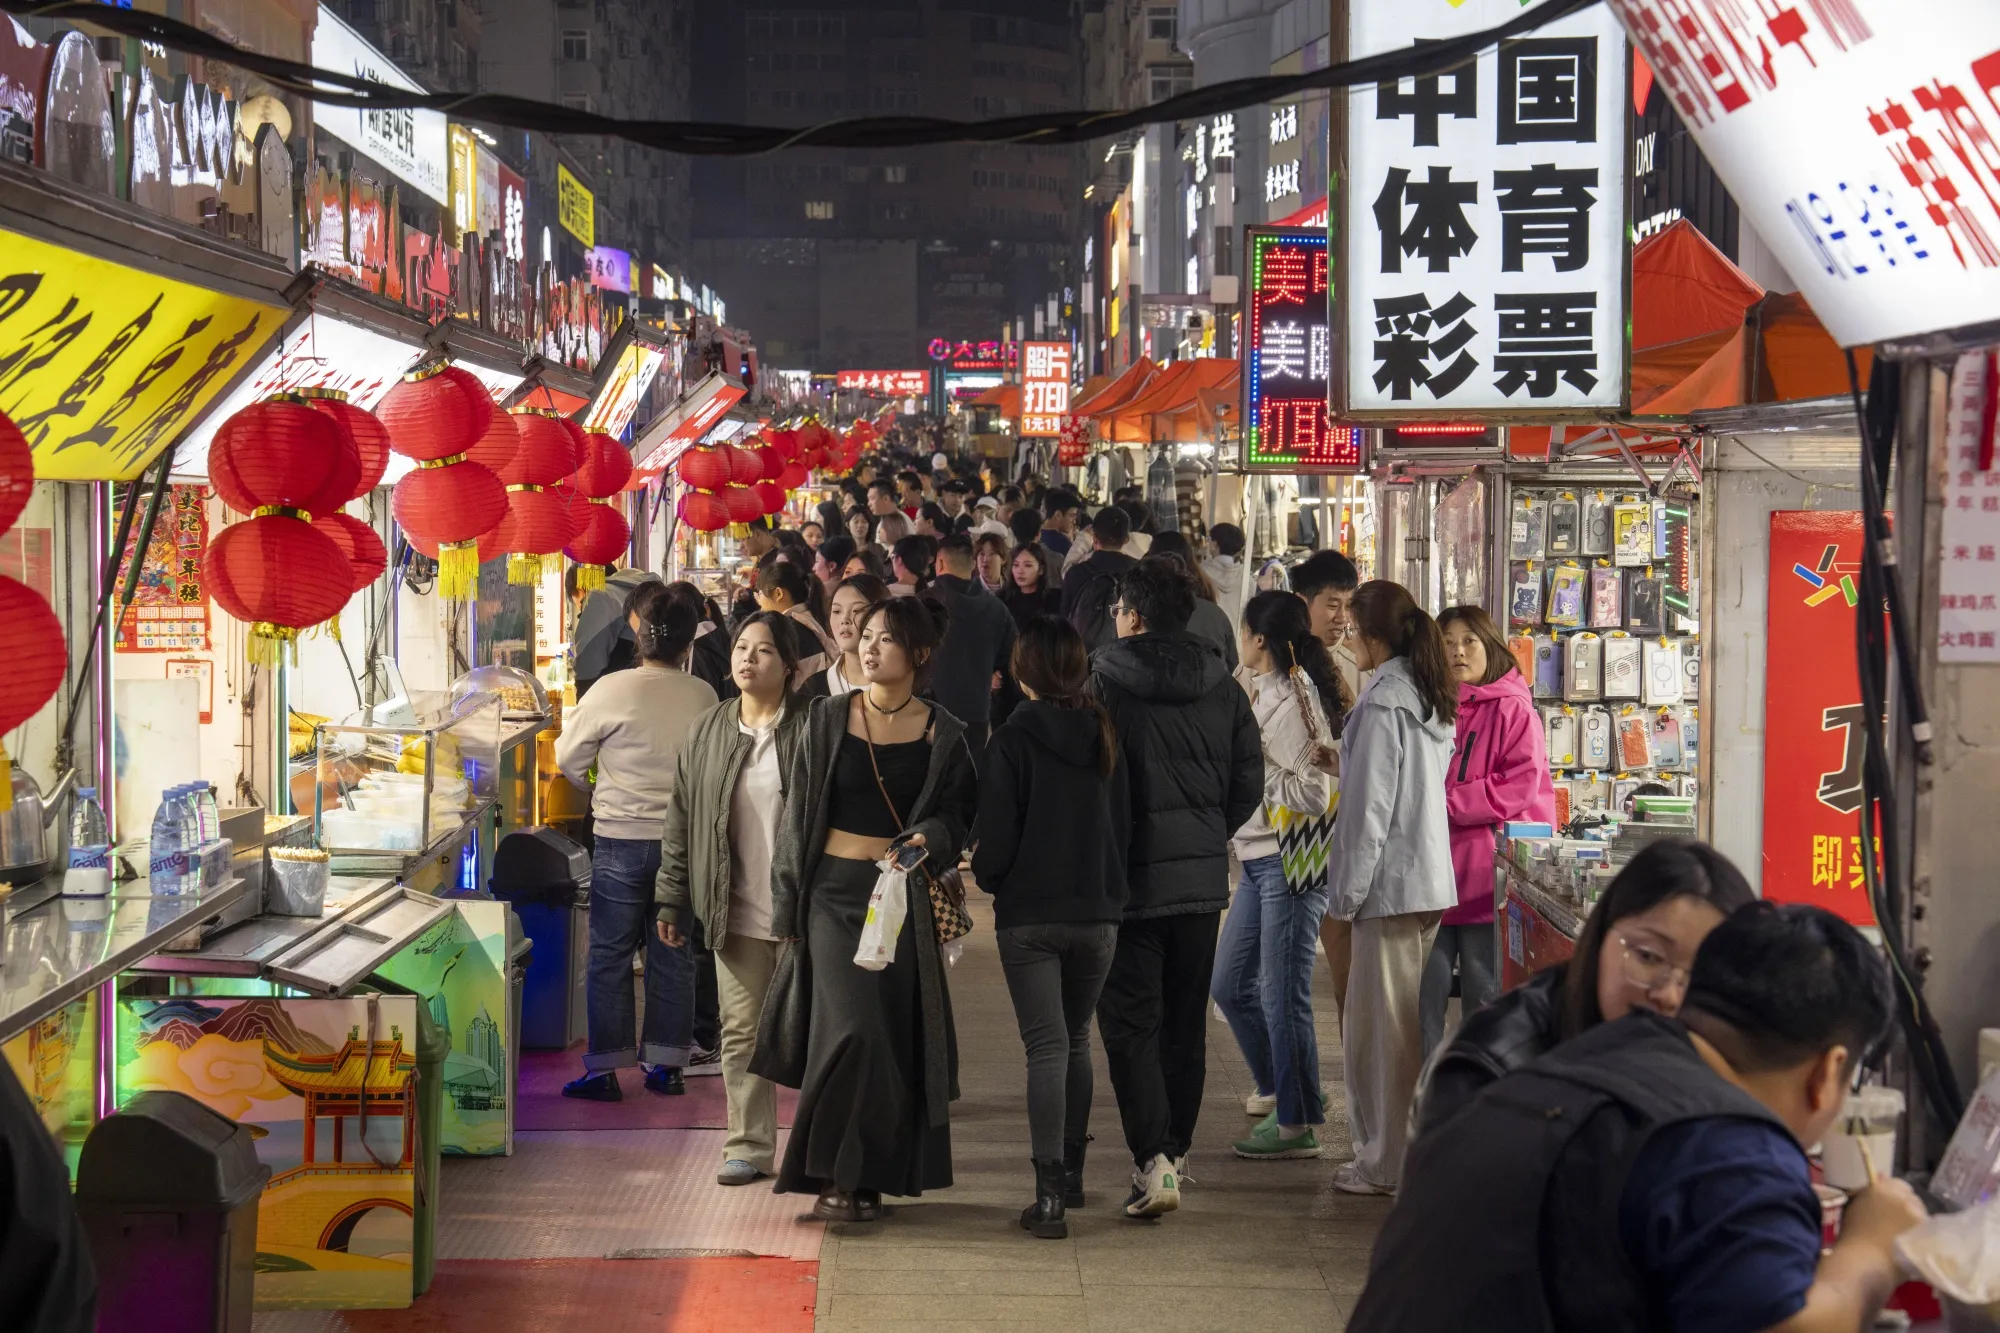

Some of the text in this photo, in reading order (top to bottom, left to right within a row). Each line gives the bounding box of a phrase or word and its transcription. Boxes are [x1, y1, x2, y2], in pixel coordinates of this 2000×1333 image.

[1376, 36, 1599, 147] 中国
[1635, 131, 1656, 177] DAY
[1865, 49, 2000, 270] 辣鸡
[1372, 163, 1599, 273] 体育
[1025, 346, 1068, 378] 照片
[1372, 291, 1599, 400] 彩票
[1024, 381, 1067, 413] 打印
[144, 638, 154, 646] 10
